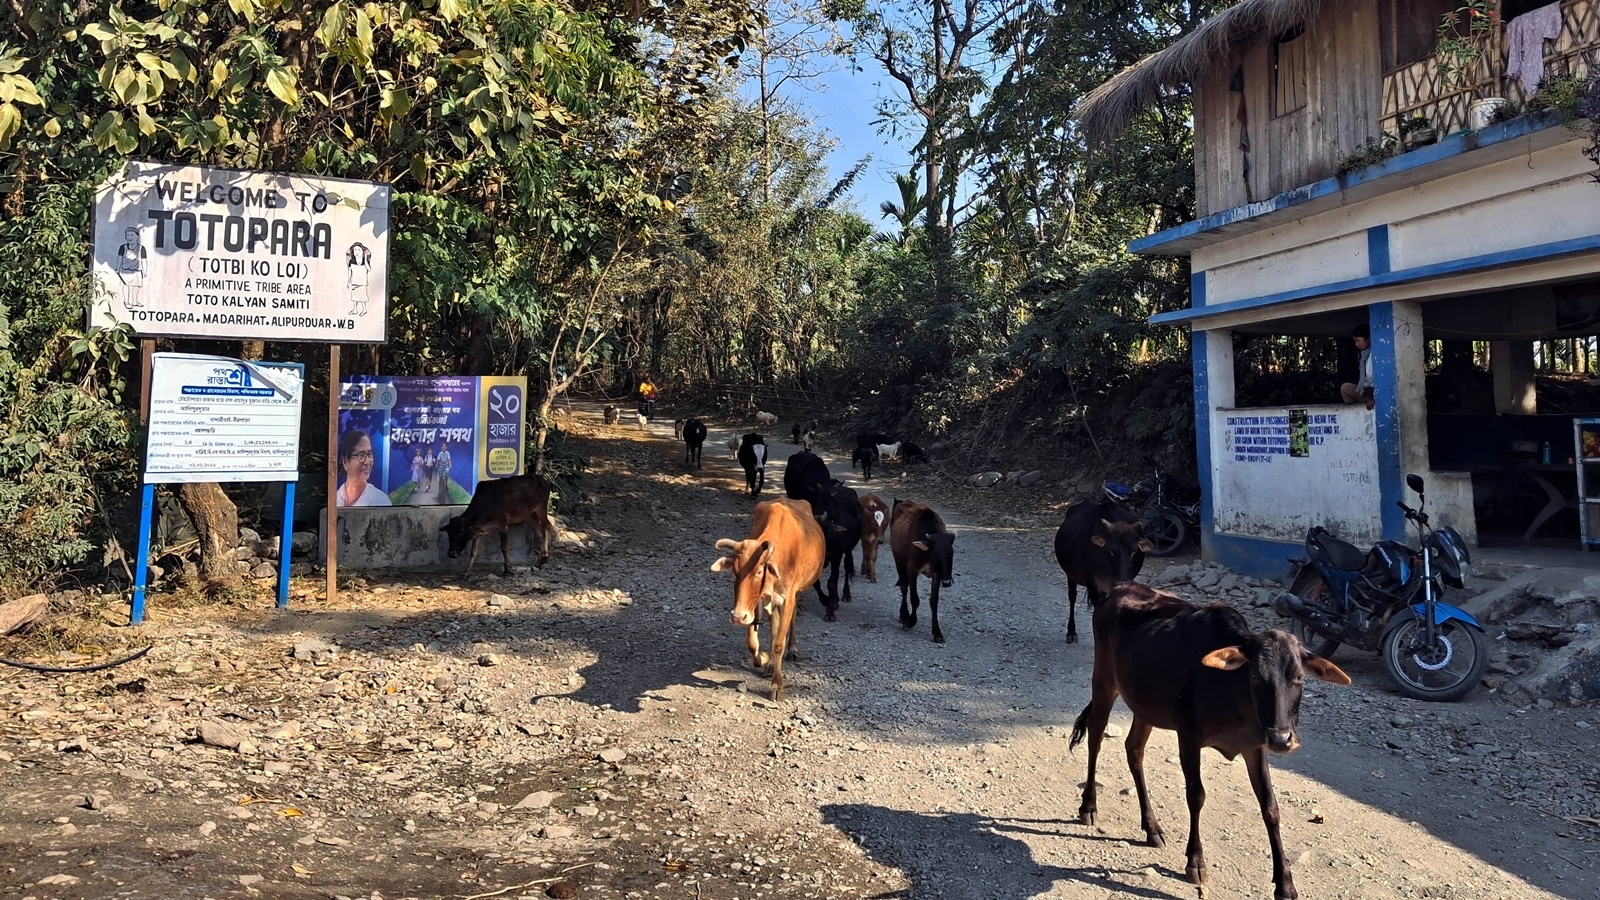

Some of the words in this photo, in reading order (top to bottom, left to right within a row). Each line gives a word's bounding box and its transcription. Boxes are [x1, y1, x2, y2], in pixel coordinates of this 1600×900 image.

[154, 179, 277, 208] WELCOME
[296, 191, 328, 213] TO
[148, 209, 332, 260] TOTOPARA
[251, 260, 270, 276] KO
[277, 262, 308, 280] LOI)
[185, 278, 192, 288] A
[196, 278, 250, 292] PRIMITIVE
[256, 281, 282, 293] TRIBE
[287, 283, 311, 295] AREA
[187, 294, 218, 306] TOTO
[222, 295, 266, 308] KALYAN
[272, 298, 310, 309] SAMITI
[489, 388, 520, 420] ২০
[1314, 414, 1327, 424] NEAR
[1328, 414, 1337, 424] THE
[391, 427, 437, 444] বাংলার
[440, 427, 473, 444] শপথ
[489, 421, 517, 437] হাজার
[1234, 427, 1244, 435] LAND
